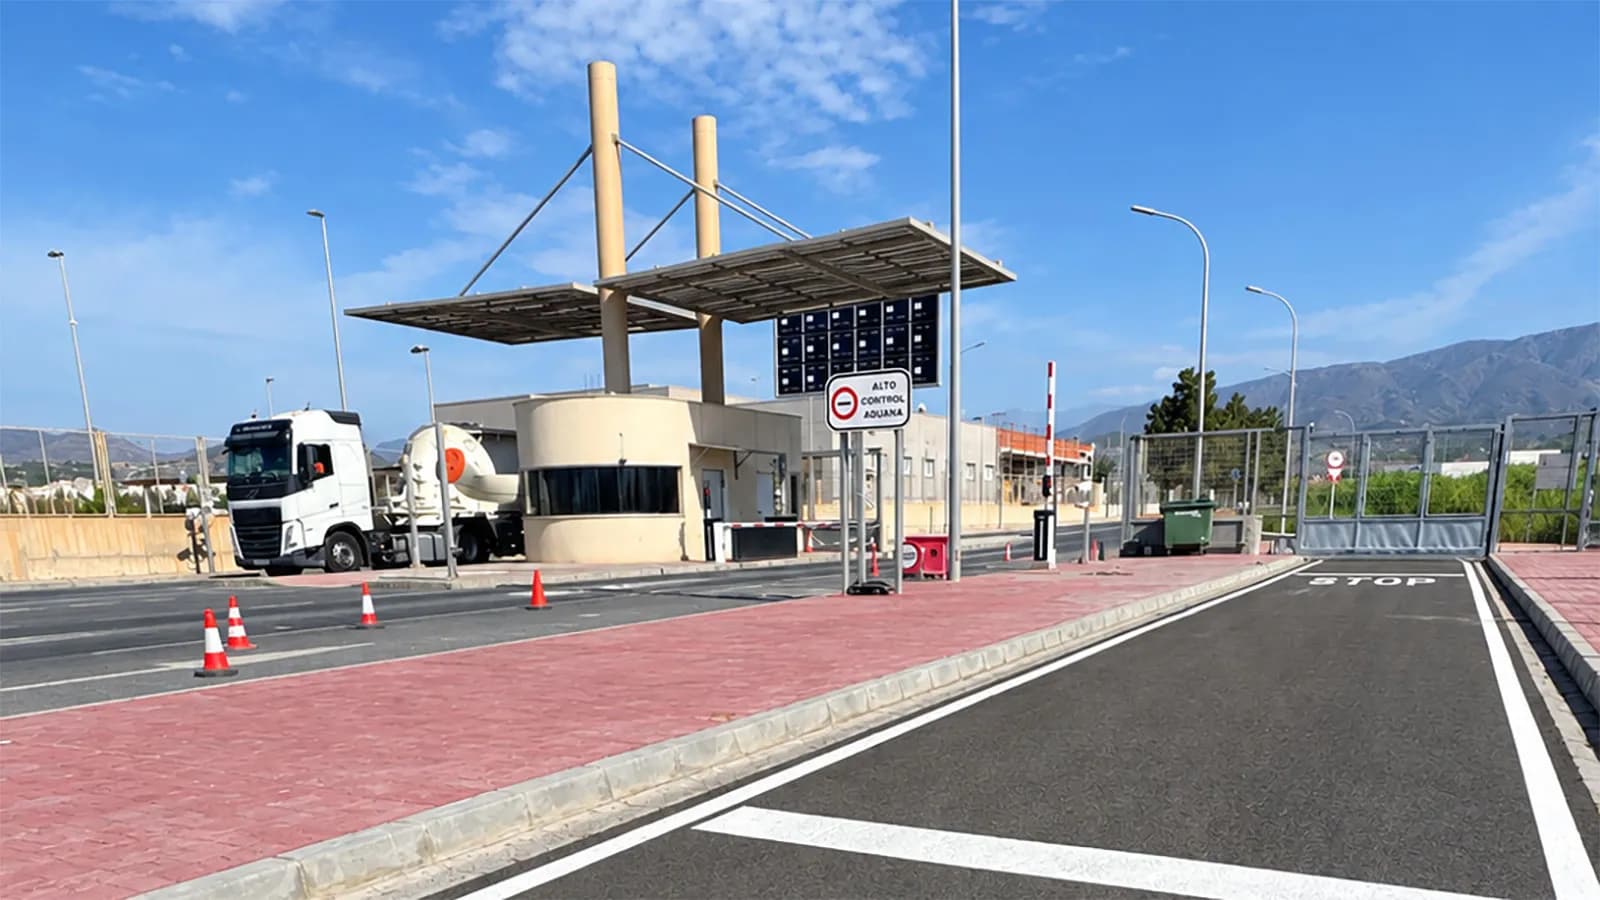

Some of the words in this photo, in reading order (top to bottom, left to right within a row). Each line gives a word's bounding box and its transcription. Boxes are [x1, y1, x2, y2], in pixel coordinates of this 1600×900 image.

[872, 380, 897, 391] ALTO
[860, 395, 905, 406] CONTROL
[863, 408, 904, 419] ADUANA
[1308, 576, 1437, 587] STOP
